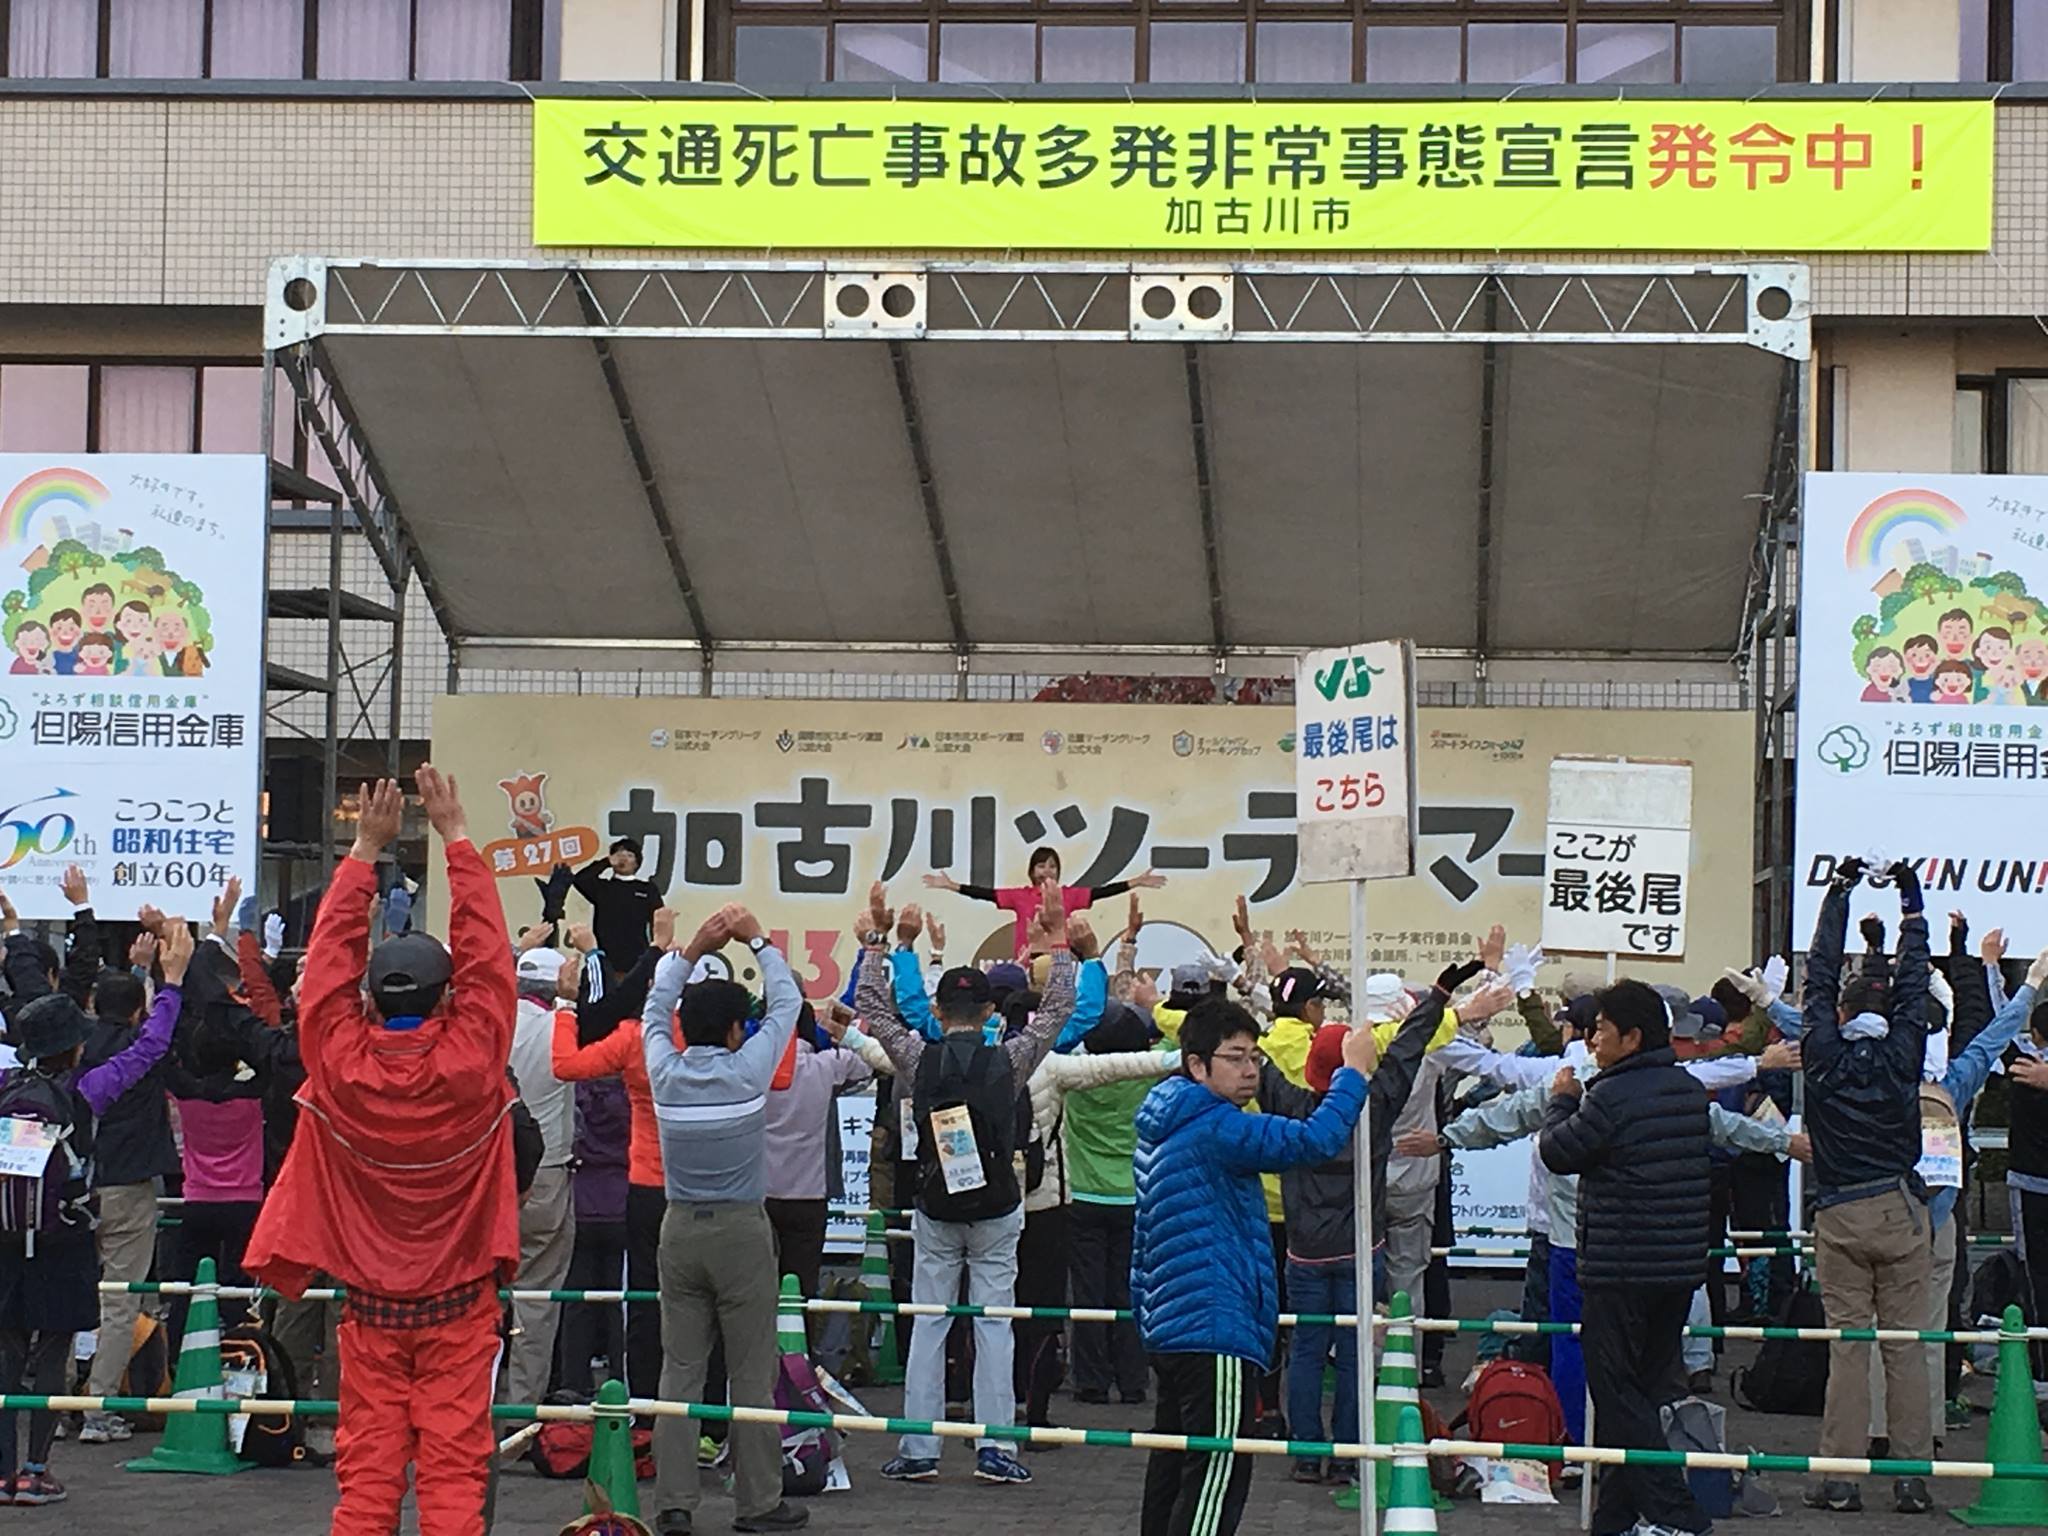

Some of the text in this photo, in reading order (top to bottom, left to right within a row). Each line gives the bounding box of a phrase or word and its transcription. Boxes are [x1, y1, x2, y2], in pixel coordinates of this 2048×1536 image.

[1166, 196, 1351, 235] 加古川市
[30, 710, 244, 749] 但陽信用金庫
[1303, 714, 1398, 759] 最後尾は
[1883, 739, 2048, 779] 但陽信用
[115, 799, 234, 824] こつこつと
[1316, 772, 1385, 812] こちら
[112, 828, 235, 855] 昭和住宅
[1553, 832, 1637, 863] ここが
[111, 861, 232, 888] 創立60年
[1549, 868, 1682, 917] 最後尾
[1622, 924, 1680, 953] です
